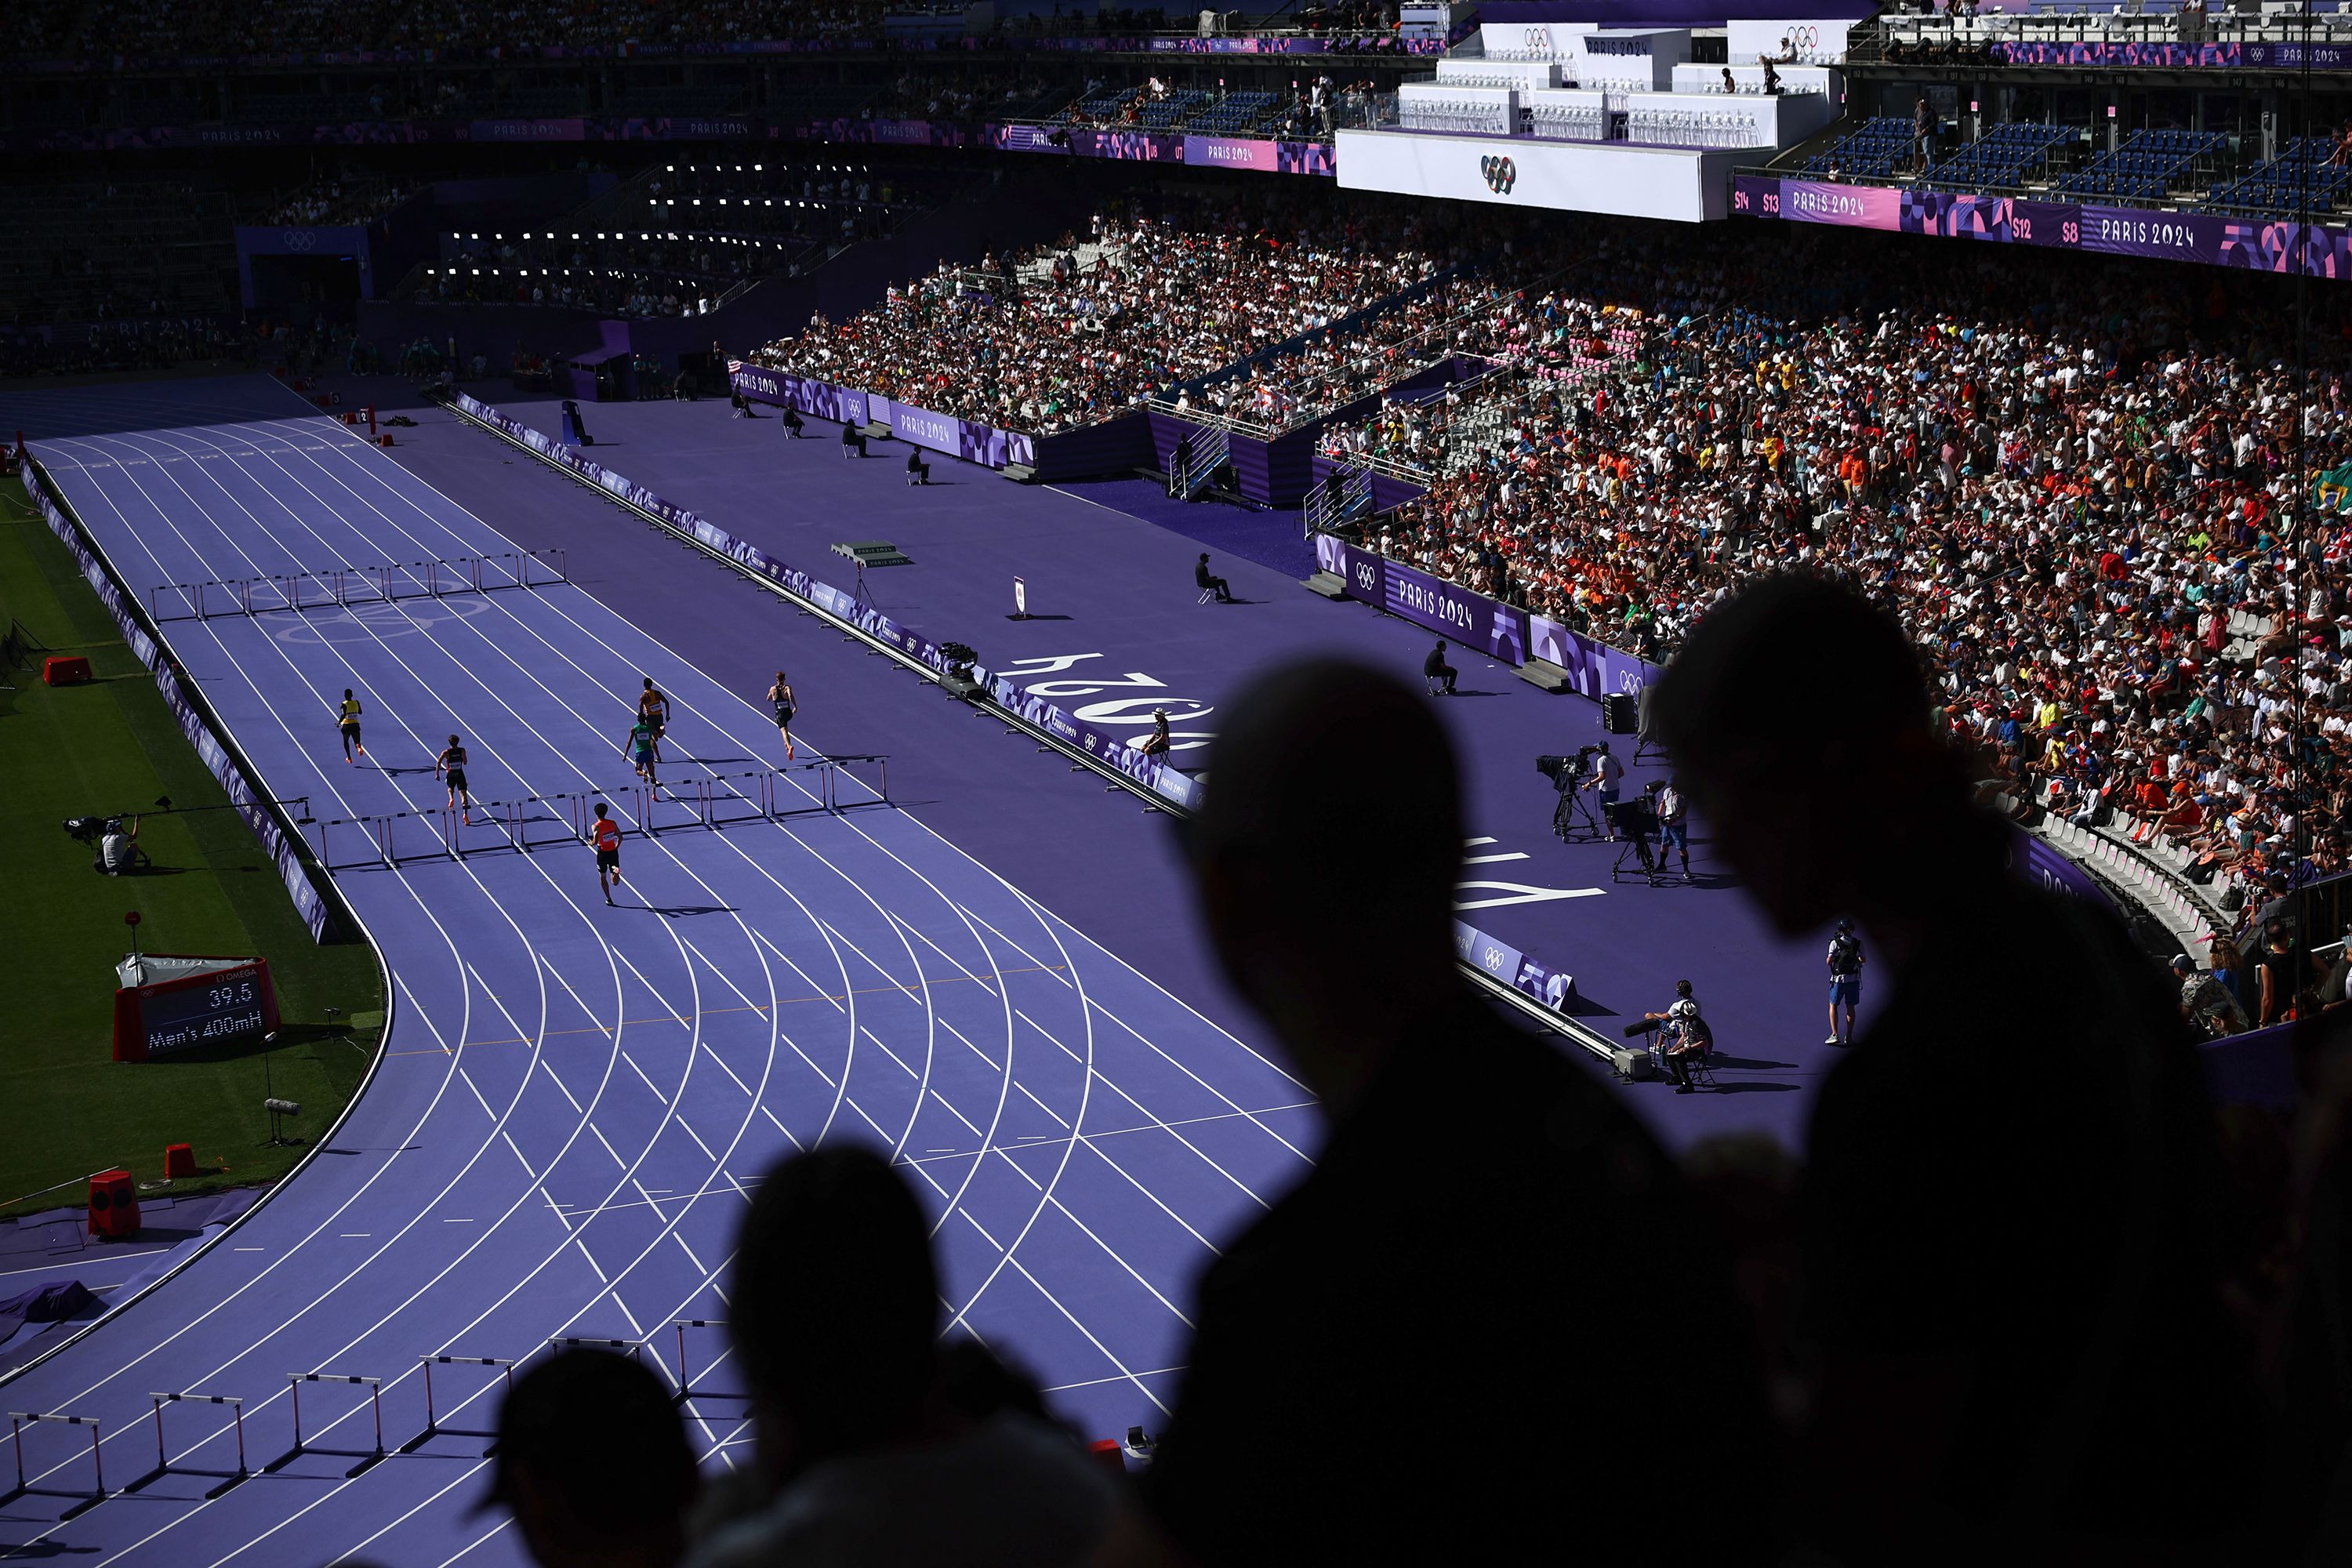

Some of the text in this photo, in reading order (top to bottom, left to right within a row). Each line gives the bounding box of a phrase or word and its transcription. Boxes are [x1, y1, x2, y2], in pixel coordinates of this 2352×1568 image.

[2315, 49, 2340, 62] 2024
[1232, 147, 1253, 162] 2024
[1734, 191, 1748, 209] S14
[1762, 193, 1779, 212] S13
[1832, 197, 1864, 216] 2024
[2012, 217, 2032, 239] S12
[2062, 221, 2078, 243] S8
[2152, 223, 2194, 247] 2024
[758, 377, 778, 396] 2024
[361, 412, 367, 422] 2
[927, 422, 949, 443] 2024
[1438, 595, 1472, 630] 2024
[1065, 725, 1077, 738] 2024
[1173, 784, 1186, 797] 2024
[226, 968, 257, 982] OMEGA
[209, 982, 252, 1009] 39.5
[148, 1011, 262, 1051] Men's 400mH
